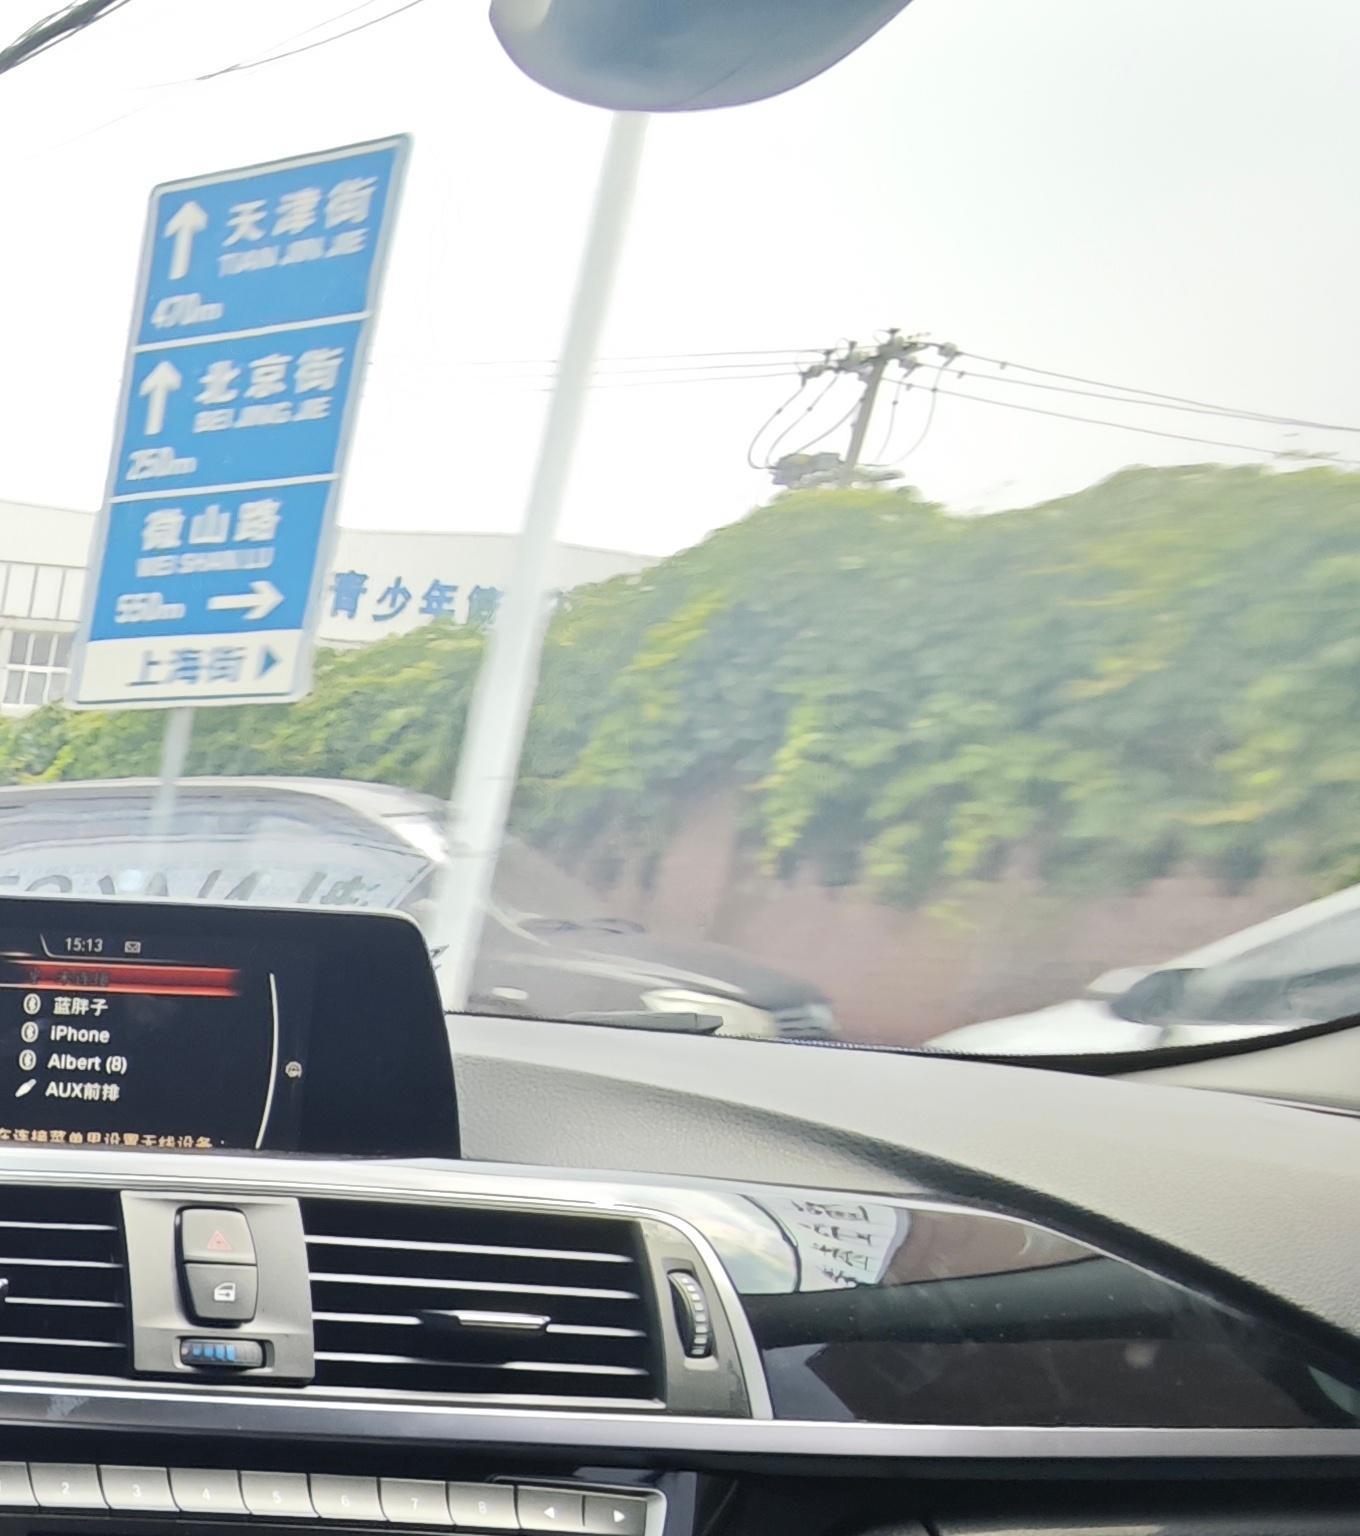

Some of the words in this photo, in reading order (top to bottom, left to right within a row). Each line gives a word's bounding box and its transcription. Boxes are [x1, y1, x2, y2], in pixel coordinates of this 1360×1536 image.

[223, 176, 378, 247] 天津街
[194, 346, 345, 405] 北京街
[141, 498, 281, 551] 微山路
[125, 645, 247, 687] 上海街
[64, 937, 104, 953] 15:13
[53, 996, 109, 1016] 蓝胖子
[50, 1024, 111, 1044] iPhone
[46, 1052, 101, 1073] Albert
[45, 1080, 120, 1102] AUX前排
[61, 1481, 69, 1496] 2
[132, 1484, 141, 1498] 3
[201, 1487, 210, 1501] 4
[272, 1489, 281, 1504] 5
[341, 1493, 350, 1508] 6
[410, 1496, 419, 1512] 7
[478, 1500, 487, 1515] 8
